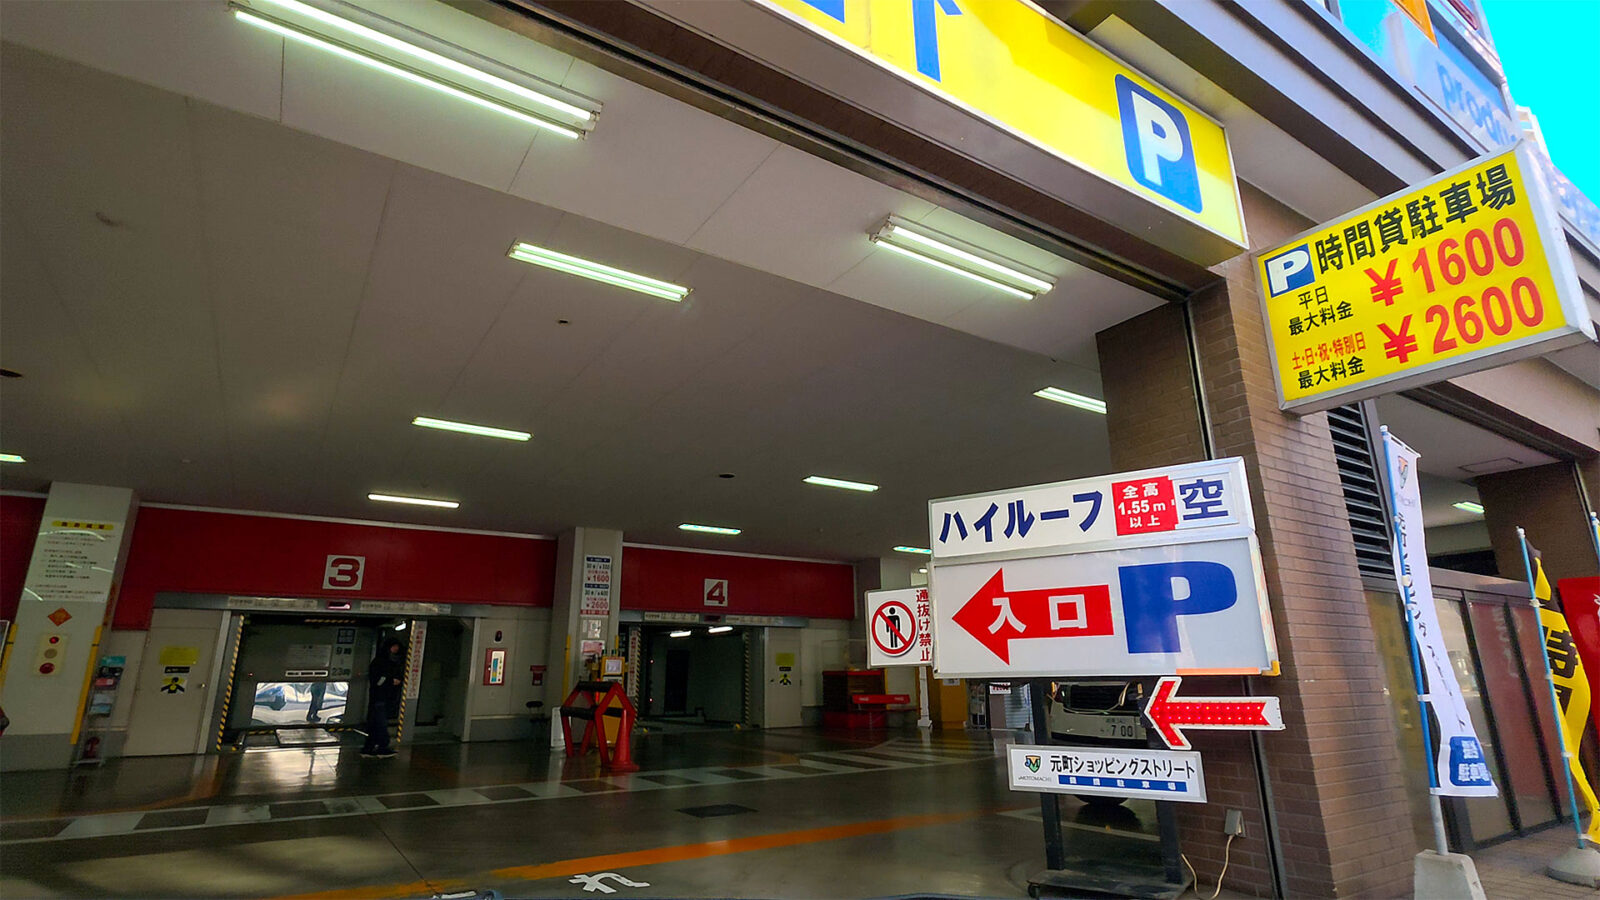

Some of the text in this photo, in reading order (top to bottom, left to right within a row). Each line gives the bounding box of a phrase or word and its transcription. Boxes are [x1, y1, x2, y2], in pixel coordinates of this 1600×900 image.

[1132, 90, 1183, 186] P
[1266, 163, 1516, 295] P 時間貸駐車場
[1298, 286, 1329, 310] 平日
[1288, 301, 1354, 336] 最大料金
[1297, 355, 1366, 390] 最大料金
[1122, 481, 1159, 500] 全高
[1179, 478, 1229, 521] 空
[938, 490, 1104, 544] ハイルーフ
[1129, 514, 1161, 529] 以上
[328, 557, 361, 588] 3
[707, 581, 725, 604] 4
[1118, 561, 1238, 654] P
[916, 589, 932, 662] 通抜け禁止
[987, 593, 1089, 635] 入口
[1050, 755, 1195, 779] 元町ショッピングストリート
